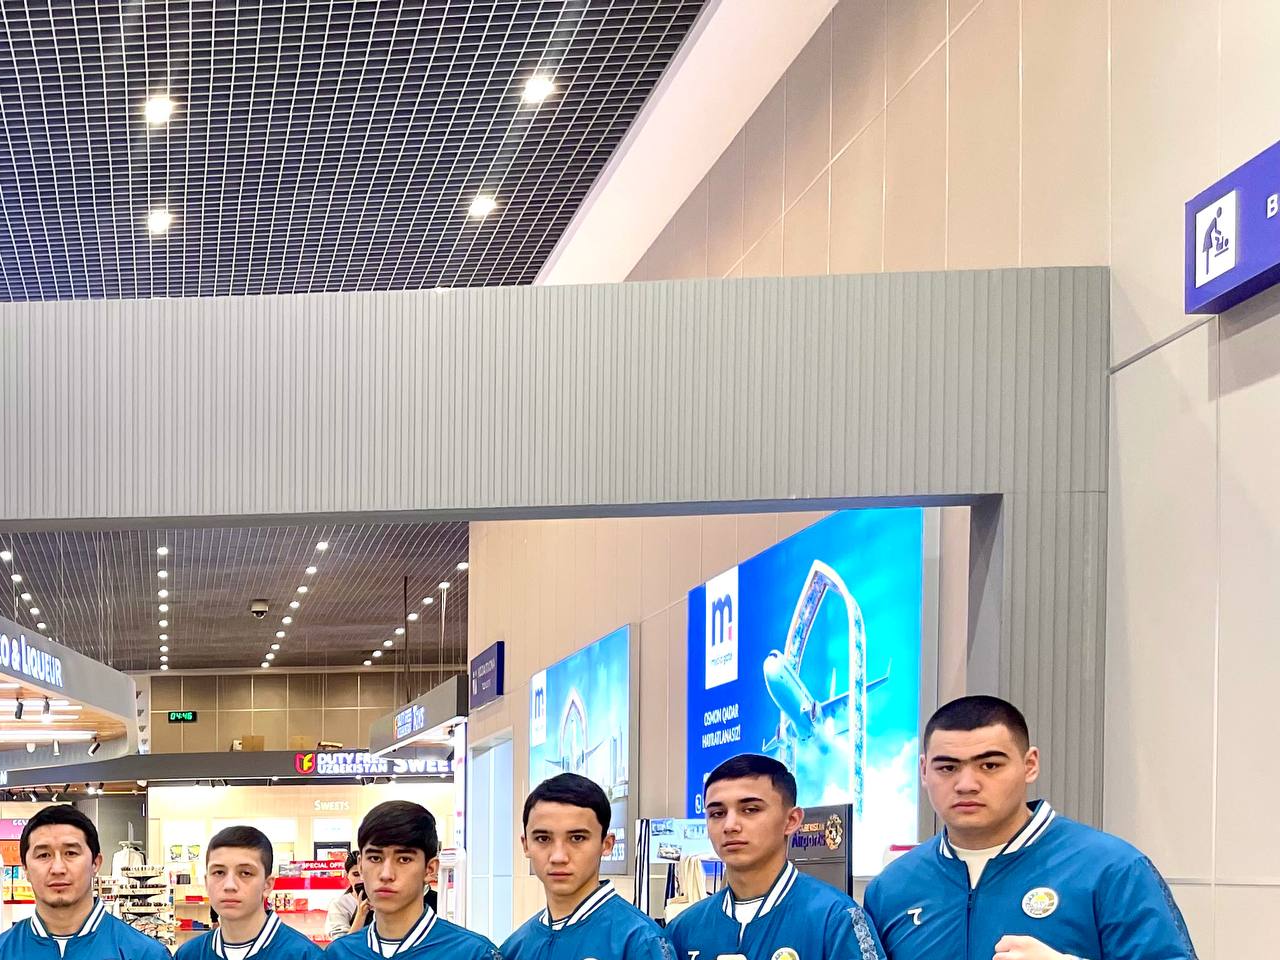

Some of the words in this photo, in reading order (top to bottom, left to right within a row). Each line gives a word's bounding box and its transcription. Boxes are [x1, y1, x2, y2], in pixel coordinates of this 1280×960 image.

[11, 638, 21, 671] &
[20, 634, 64, 688] LIQUEUR
[317, 752, 353, 765] DUTY
[317, 763, 389, 774] UZBEKISTAN
[314, 799, 350, 811] SWEETS
